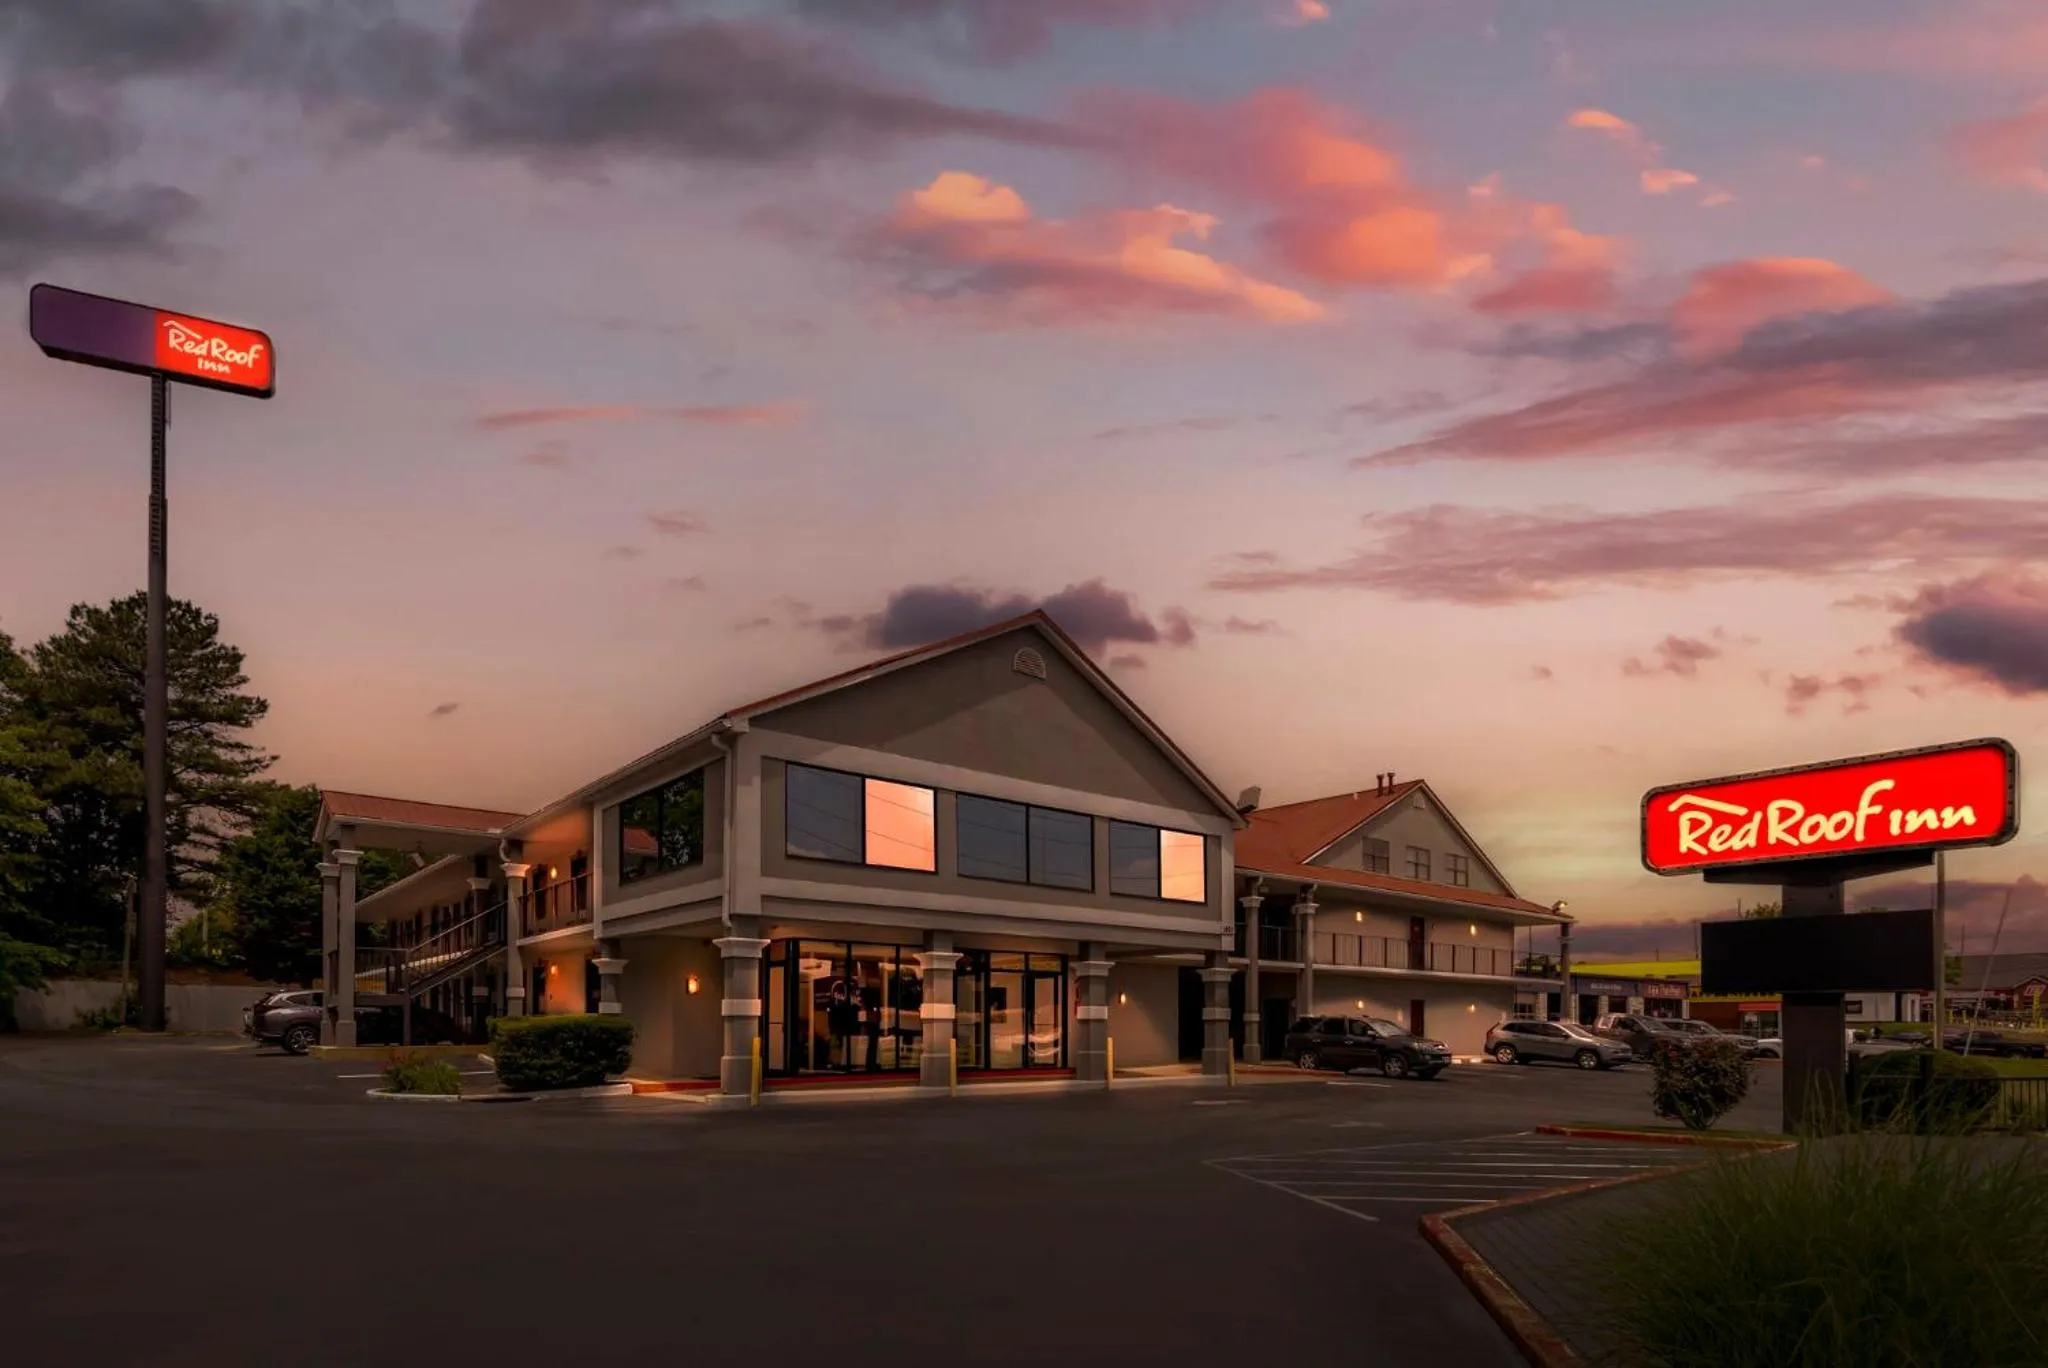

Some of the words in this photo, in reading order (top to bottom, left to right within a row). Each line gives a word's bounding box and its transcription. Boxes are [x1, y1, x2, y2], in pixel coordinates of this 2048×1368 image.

[168, 329, 209, 356] Red
[212, 339, 263, 367] Roof
[1679, 810, 1762, 855] Red
[1767, 779, 1895, 847] Roof
